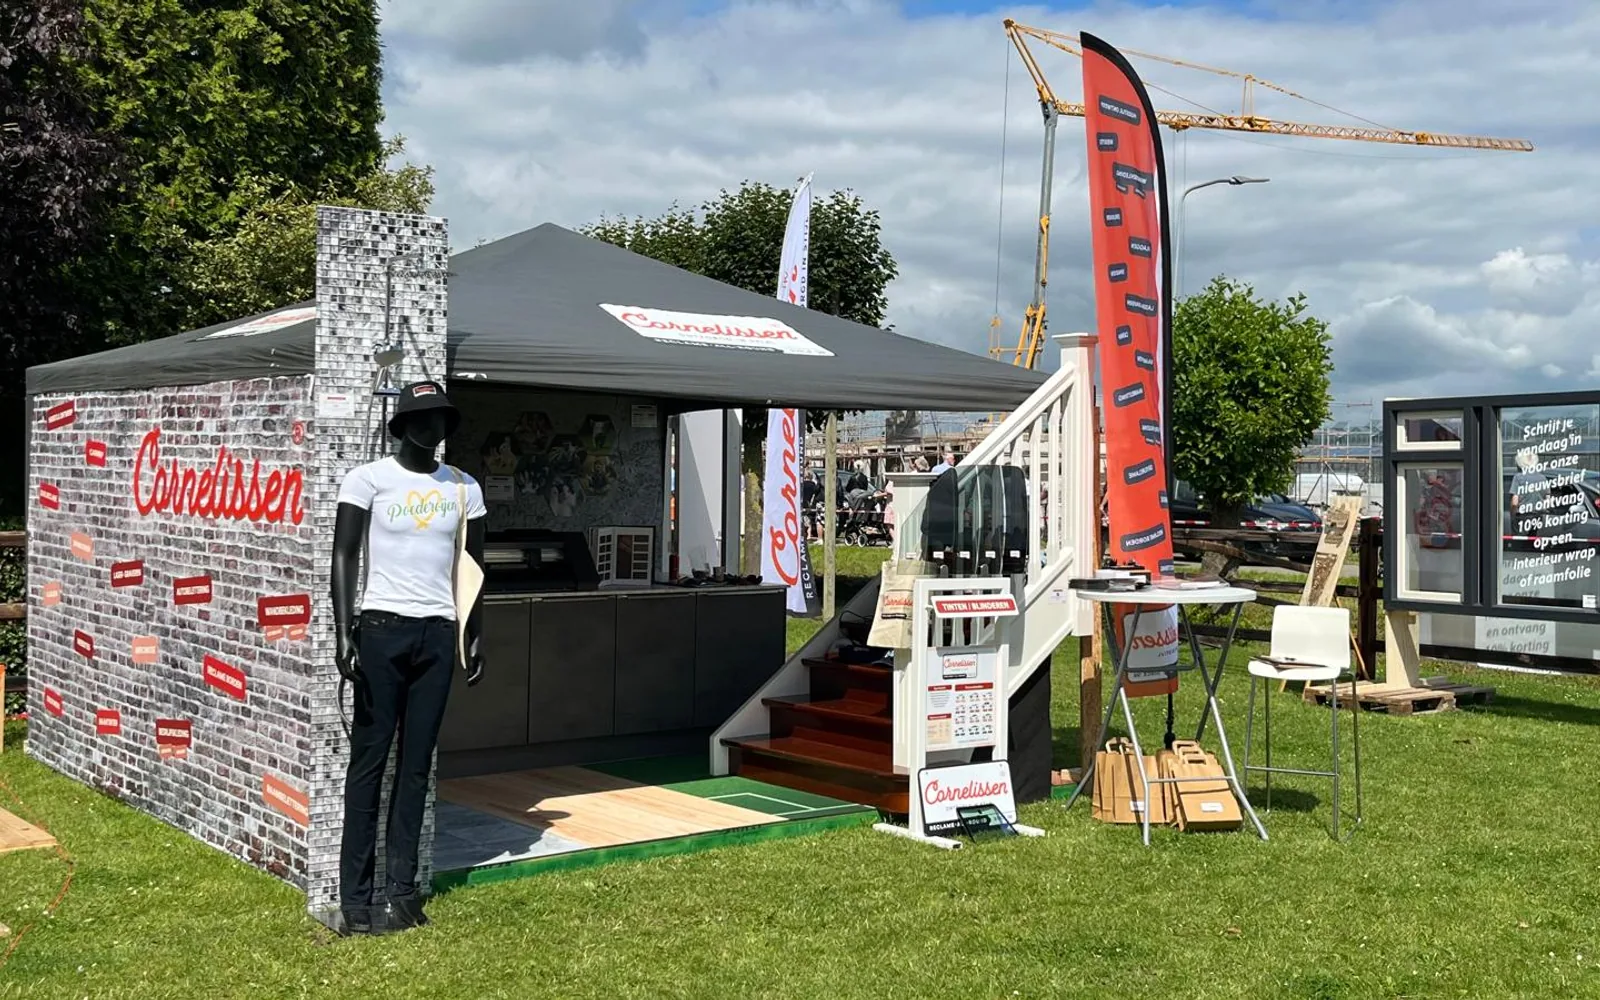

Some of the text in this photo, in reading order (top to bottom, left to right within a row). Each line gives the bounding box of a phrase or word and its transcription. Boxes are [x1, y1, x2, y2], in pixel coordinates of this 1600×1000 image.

[620, 312, 798, 341] Cornelissen
[1523, 419, 1574, 439] Schrijf je
[1517, 433, 1582, 457] vandaag in
[1521, 454, 1579, 475] voor onze
[132, 427, 304, 526] Cornelissen
[1517, 469, 1586, 495] nieuwsbrief
[1518, 491, 1585, 515] en ontvang
[1518, 510, 1589, 533] 10% korting
[1533, 532, 1573, 551] op een
[1513, 546, 1597, 571] interieur wrap
[1519, 574, 1533, 589] of
[1533, 566, 1592, 587] raamfolie
[942, 603, 967, 612] TINTEN
[971, 600, 1010, 611] BLINDEREN
[1486, 622, 1547, 638] en ontvang
[1510, 640, 1551, 653] korting
[924, 779, 1009, 805] Cornelissen
